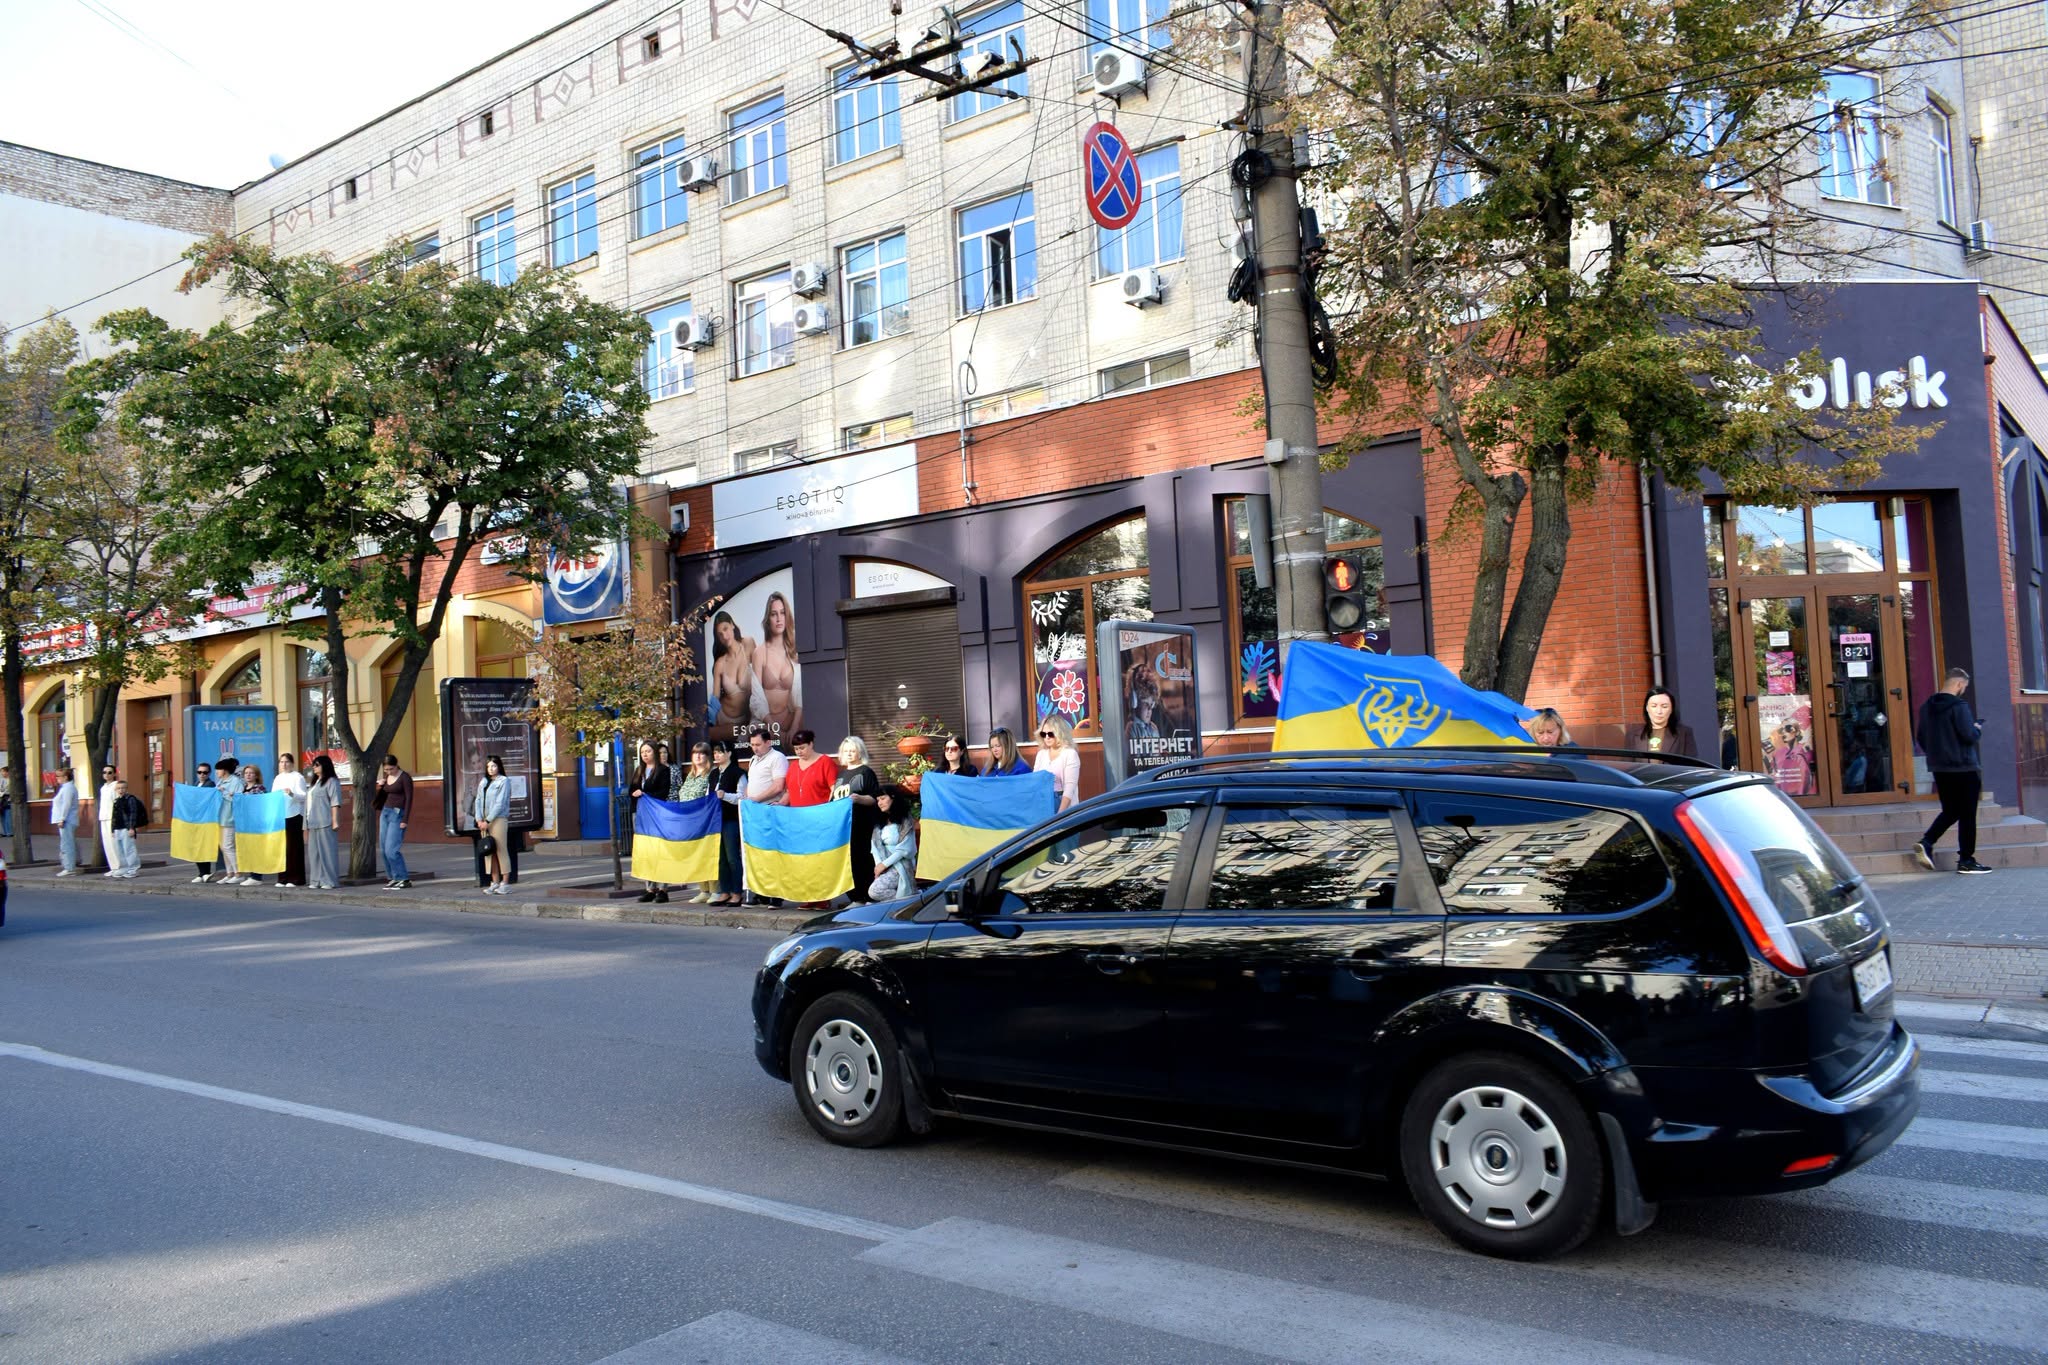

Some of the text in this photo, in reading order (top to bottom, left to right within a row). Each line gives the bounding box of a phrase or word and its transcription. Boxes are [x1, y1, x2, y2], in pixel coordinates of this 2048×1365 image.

[777, 486, 843, 510] ESOTIQ
[868, 573, 899, 583] ESOTIQ
[1121, 631, 1139, 643] 1024
[1844, 646, 1869, 657] 8-21
[203, 717, 265, 734] TAXI 838
[732, 722, 780, 737] ESOTIQ
[1129, 737, 1193, 755] ІНТЕРНЕТ
[1134, 758, 1144, 767] ТА
